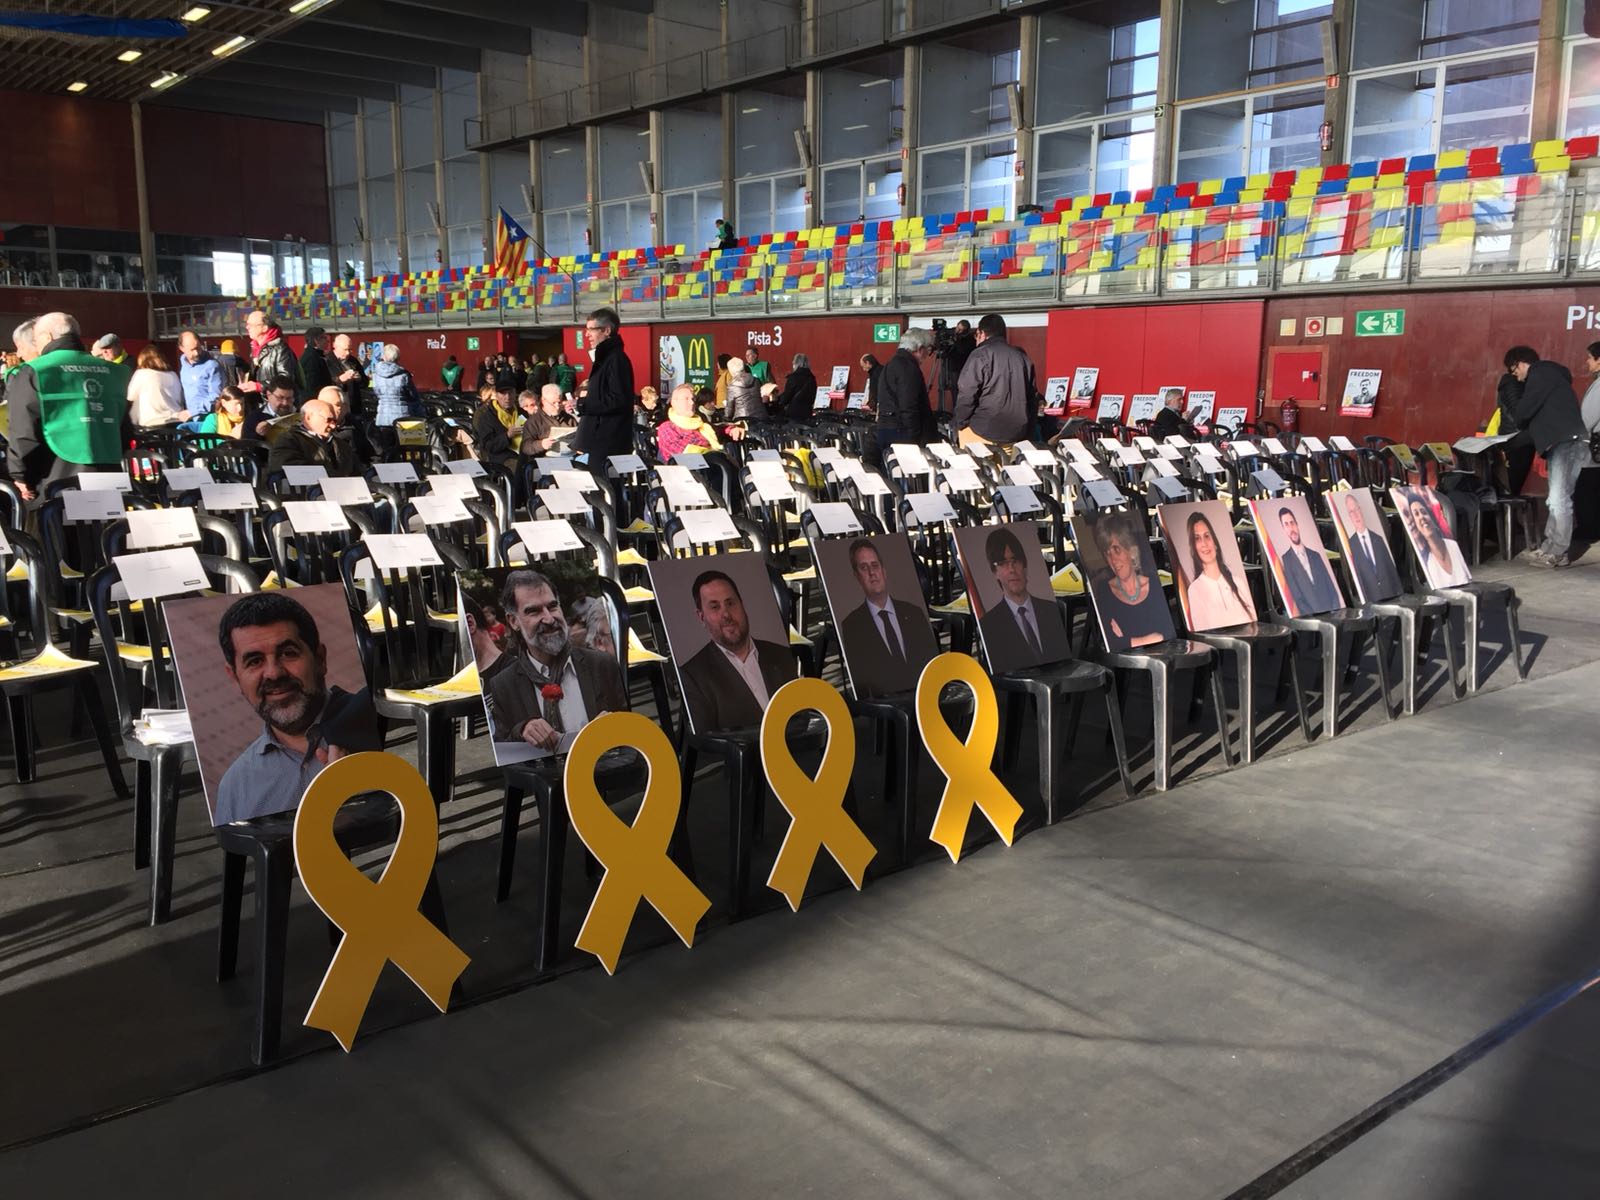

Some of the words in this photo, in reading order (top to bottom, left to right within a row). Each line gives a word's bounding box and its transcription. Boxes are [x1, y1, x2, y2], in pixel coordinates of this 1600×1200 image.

[427, 339, 440, 349] Pista
[440, 334, 447, 349] 2
[748, 331, 771, 345] Pista
[773, 325, 783, 346] 3
